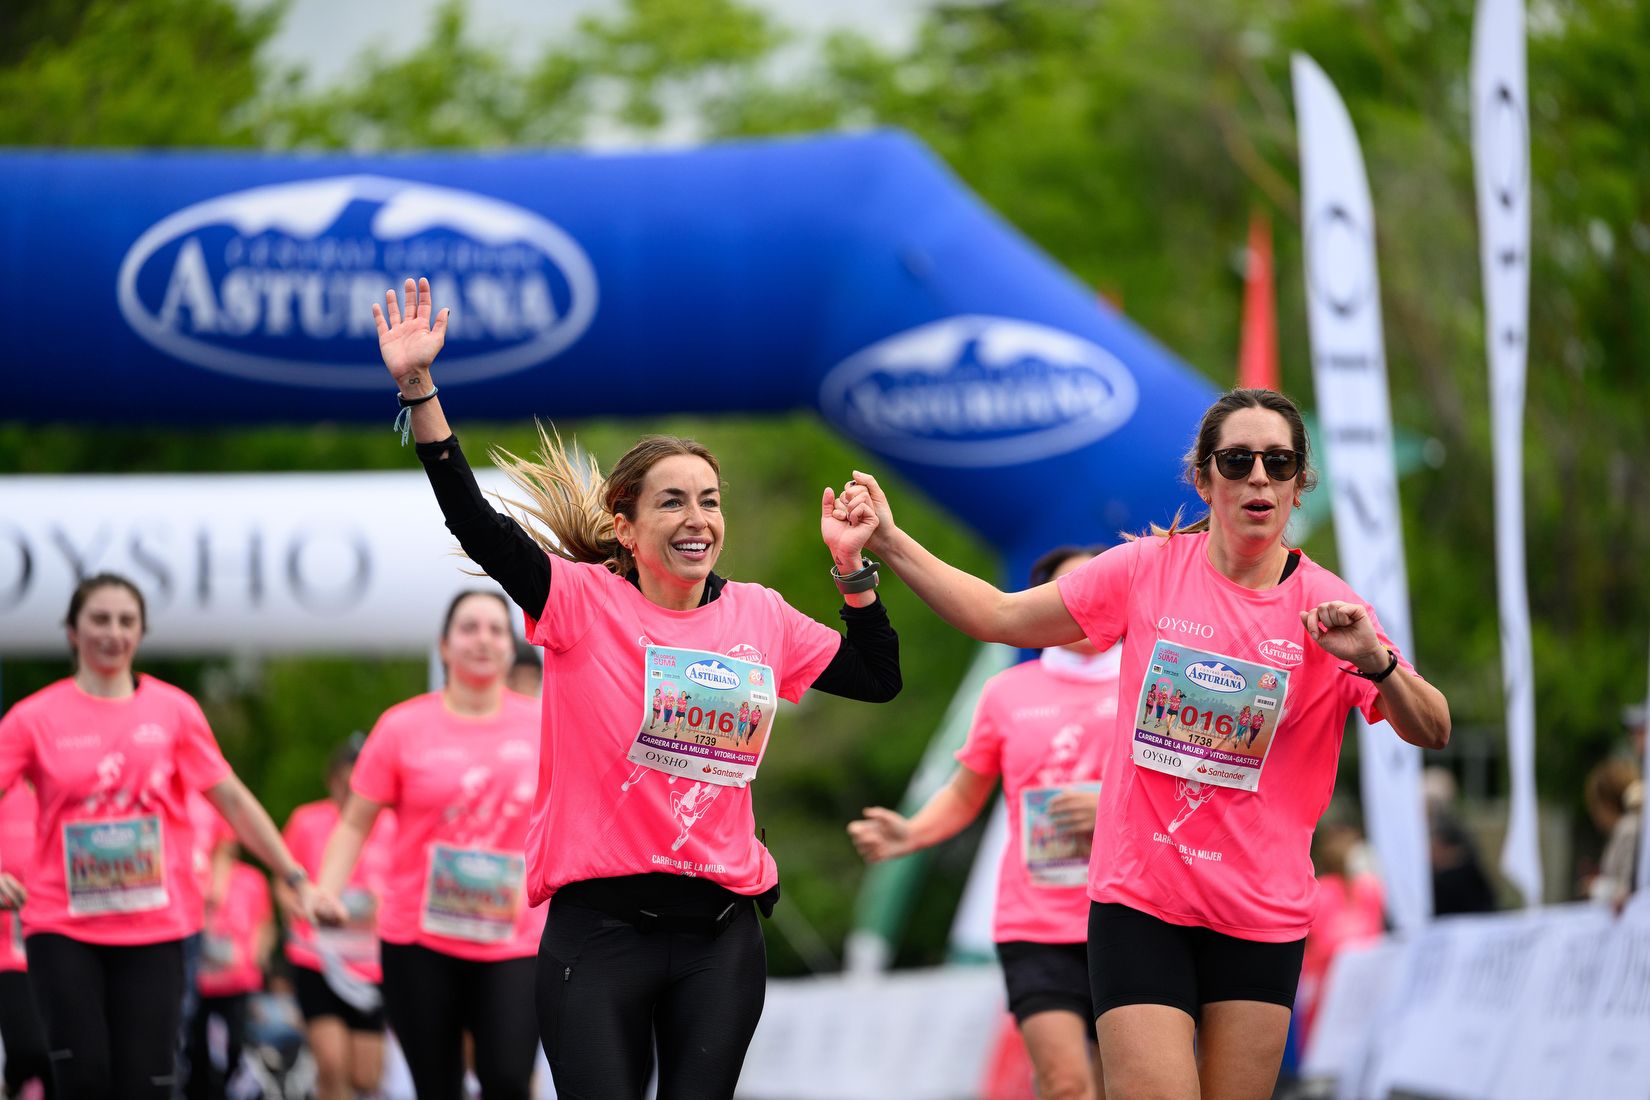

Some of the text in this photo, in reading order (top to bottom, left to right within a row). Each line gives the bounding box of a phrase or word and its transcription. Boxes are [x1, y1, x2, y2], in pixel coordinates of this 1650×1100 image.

[158, 236, 561, 343] ASTURANA
[1158, 616, 1214, 639] OYSHO
[653, 657, 676, 668] SUMA
[1157, 652, 1178, 665] SUMA
[689, 667, 737, 686] ASTURIANA
[1188, 666, 1242, 689] ASTURIANA
[687, 706, 735, 733] 016
[1180, 705, 1234, 735] 016
[641, 735, 756, 763] CARRERA DE LA MUJER VITORIA-GASTEIZ
[694, 734, 717, 747] 1739
[1138, 731, 1259, 766] CARRERA DE LA MUJER VITORIA-GASTEIZ
[1188, 733, 1213, 748] 1738
[645, 751, 688, 769] OYSHO
[1142, 748, 1182, 768] OYSHO
[711, 766, 745, 779] Santander
[1207, 767, 1245, 781] Santander
[1179, 844, 1188, 854] DE
[1188, 847, 1197, 857] LA
[1197, 849, 1223, 862] MUJER
[651, 854, 727, 873] CARRERA DE LA MUJER
